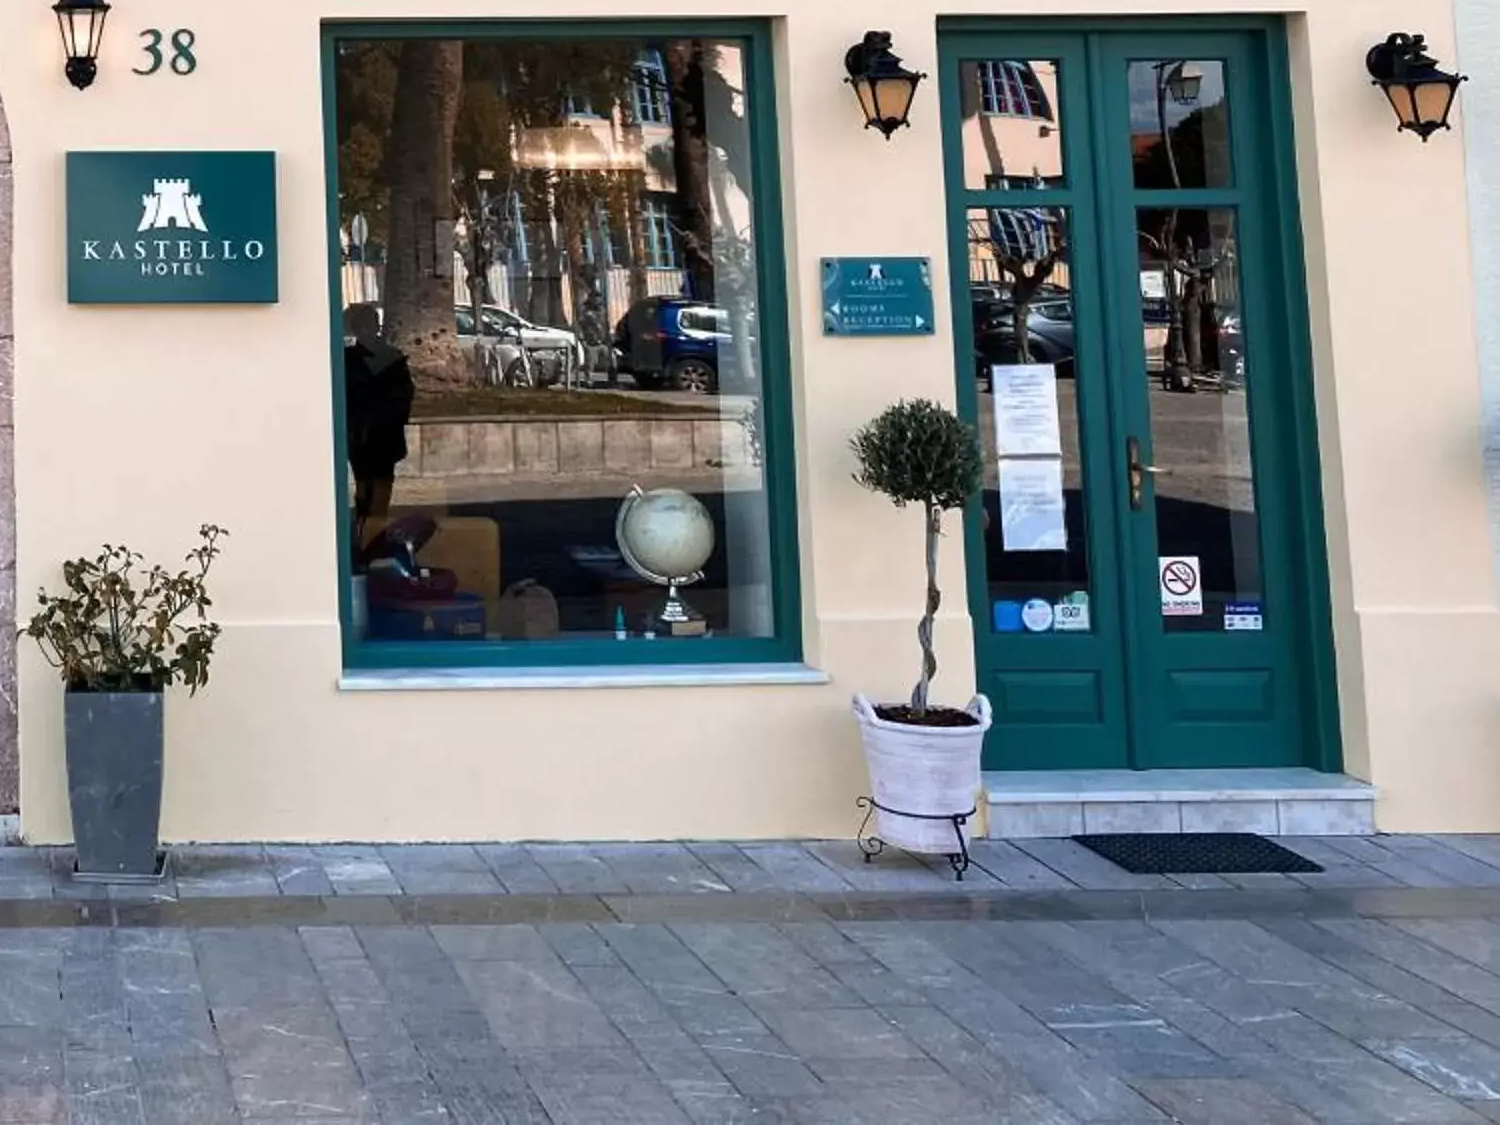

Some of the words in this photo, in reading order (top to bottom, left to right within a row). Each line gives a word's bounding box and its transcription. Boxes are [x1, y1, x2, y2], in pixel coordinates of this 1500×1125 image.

[132, 28, 197, 76] 38
[82, 239, 265, 261] KASTELLO
[140, 262, 205, 276] HOTEL
